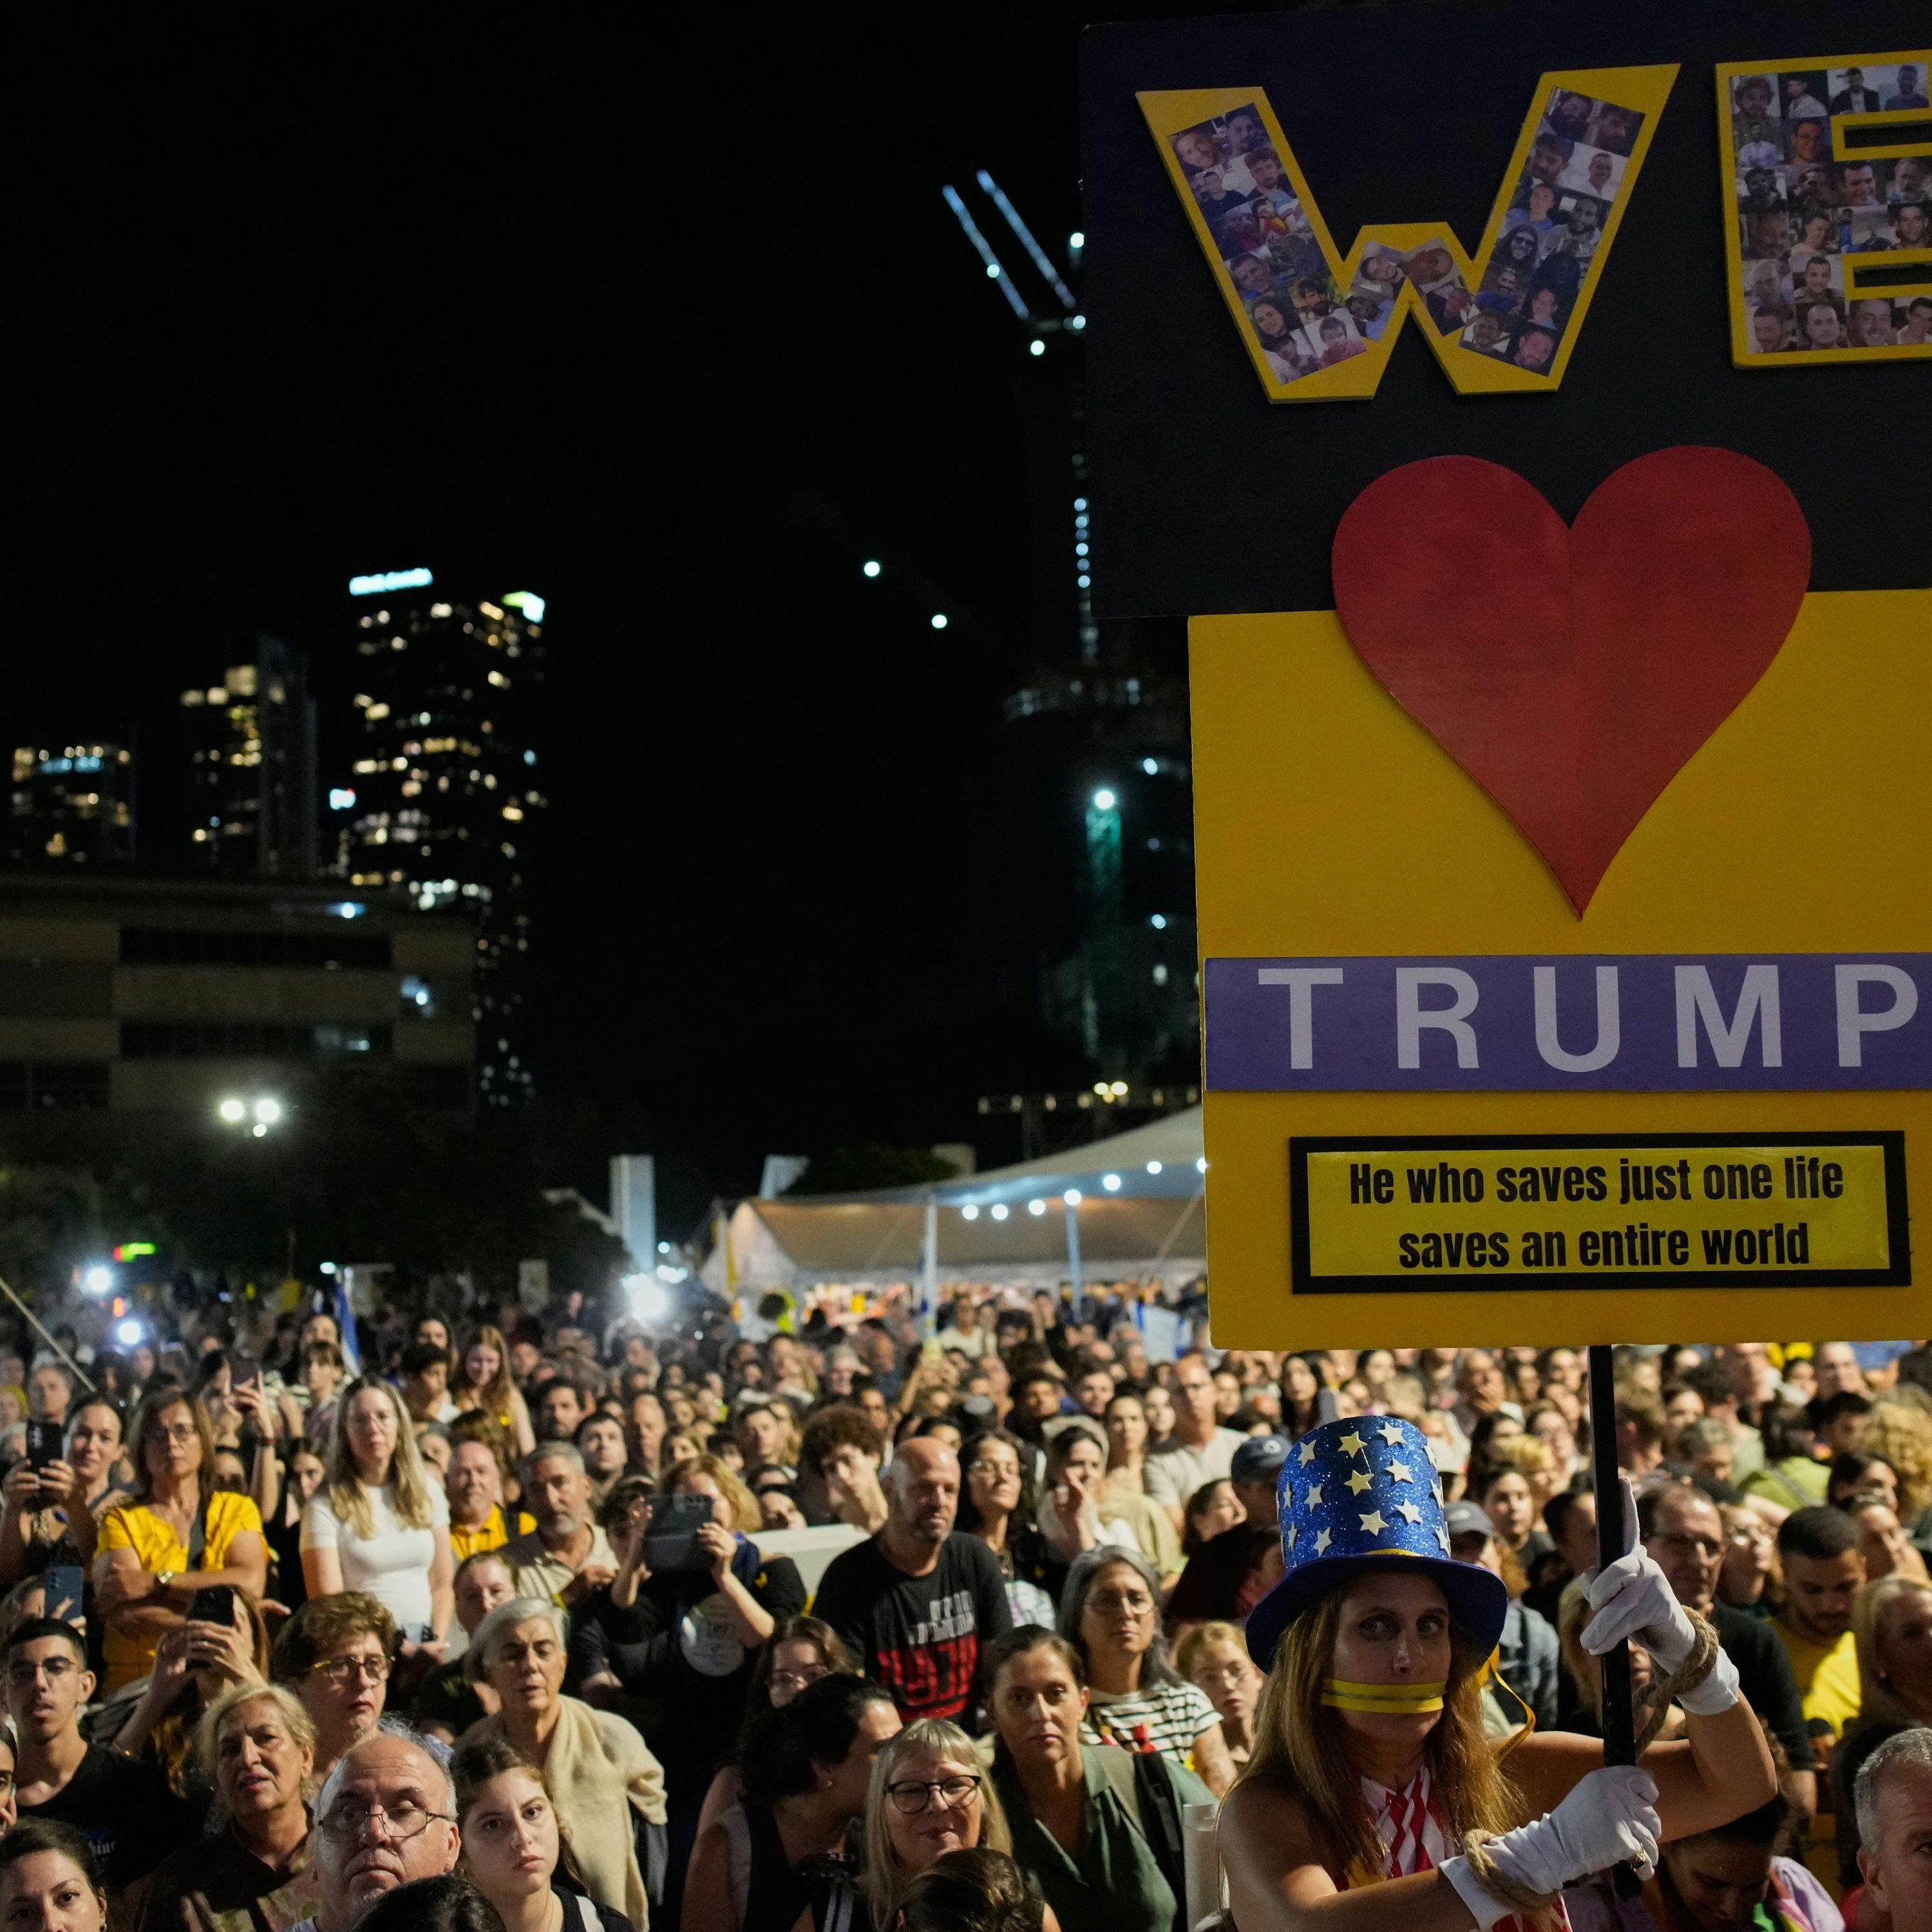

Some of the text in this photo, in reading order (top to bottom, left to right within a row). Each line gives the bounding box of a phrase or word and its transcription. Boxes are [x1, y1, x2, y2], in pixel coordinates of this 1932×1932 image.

[1135, 50, 1932, 404] WE
[1258, 964, 1918, 1073] TRUMP
[1349, 1155, 1844, 1205] He who saves just one life
[1398, 1222, 1810, 1269] saves an entire world
